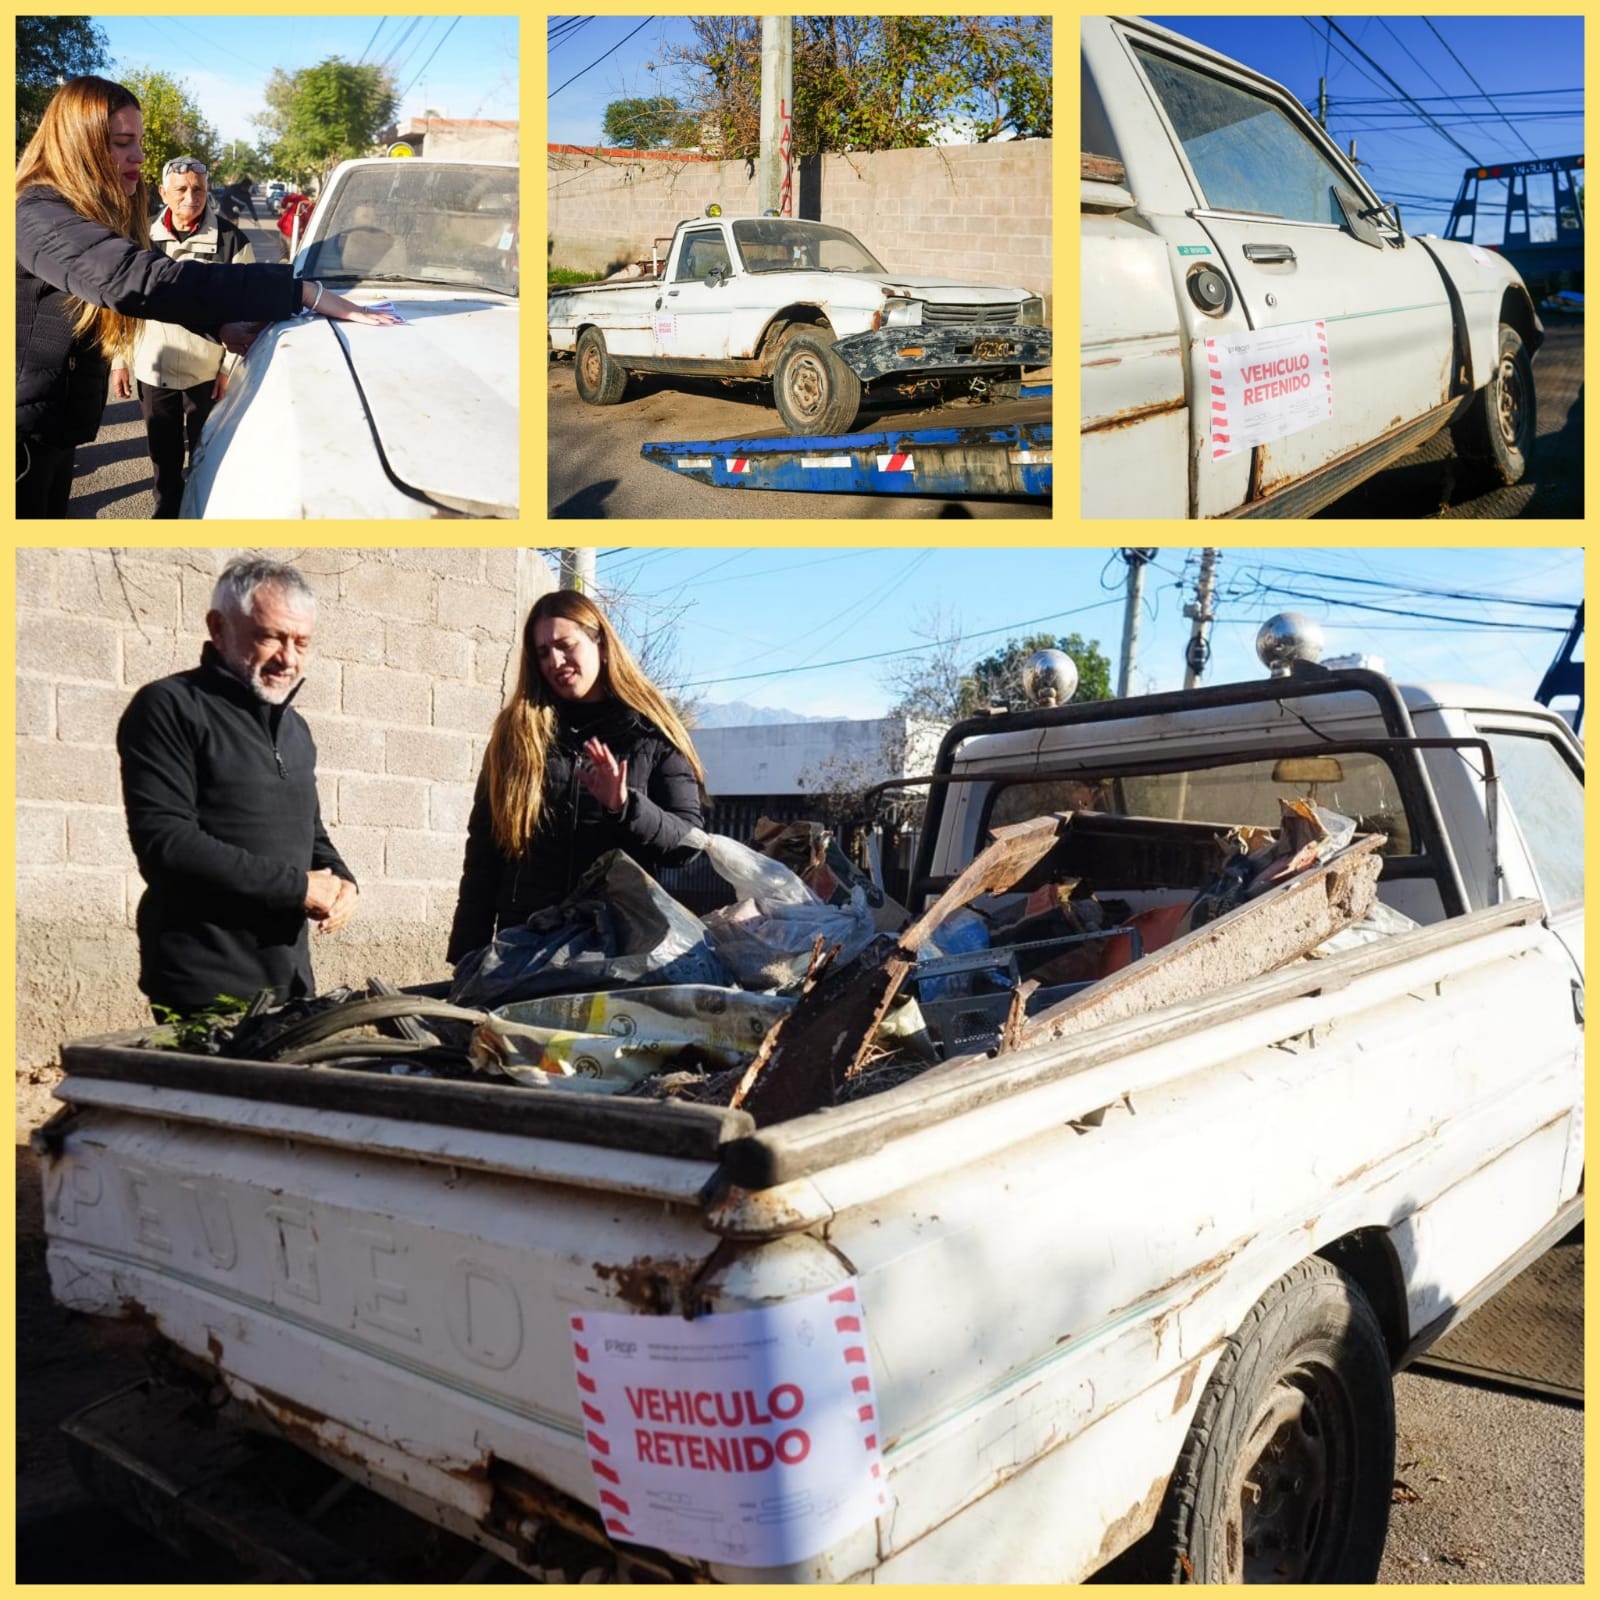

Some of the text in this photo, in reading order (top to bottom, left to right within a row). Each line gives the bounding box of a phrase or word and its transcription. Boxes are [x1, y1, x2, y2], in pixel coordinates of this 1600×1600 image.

[1240, 353, 1310, 384] VEHICULO
[1243, 373, 1311, 406] RETENIDO
[50, 1160, 602, 1373] PEUGEO
[624, 1383, 805, 1428] VEHICULO
[634, 1428, 811, 1473] RETENIDO
